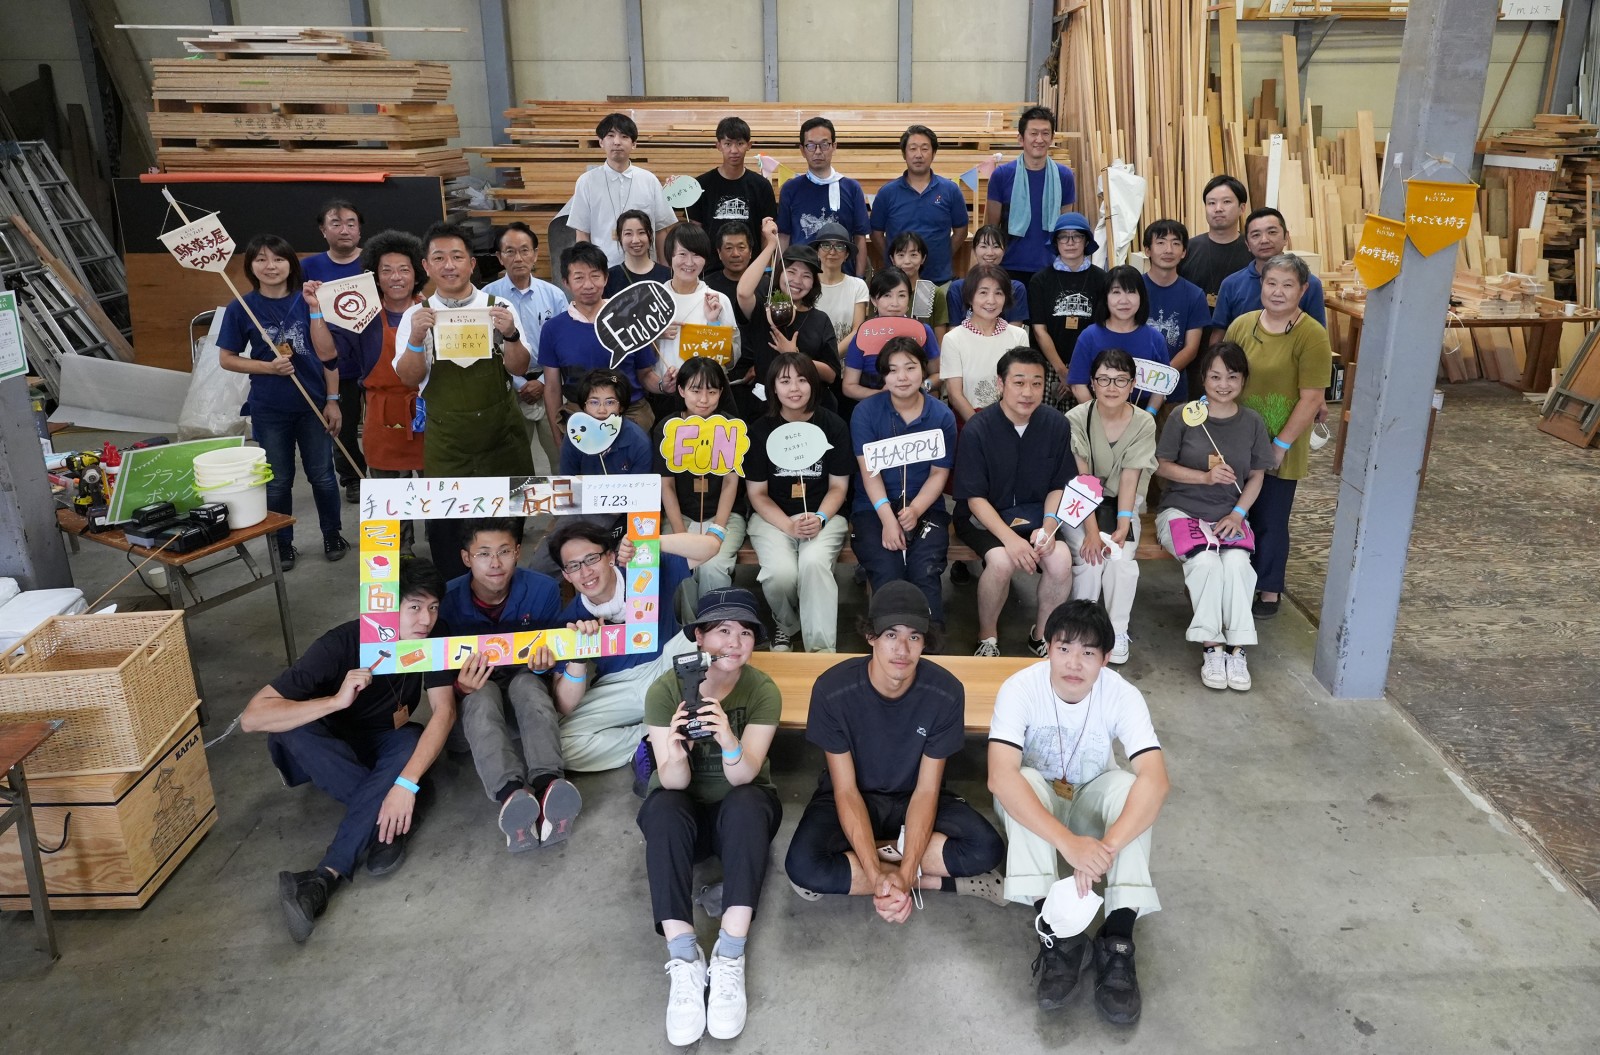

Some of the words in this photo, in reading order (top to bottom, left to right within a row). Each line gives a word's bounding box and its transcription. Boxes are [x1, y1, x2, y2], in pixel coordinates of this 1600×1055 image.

[1408, 213, 1468, 230] 木のこども椅子
[173, 227, 230, 261] 駄菓子屋
[1358, 244, 1401, 267] 木の学童椅子
[601, 282, 673, 352] Enjoy!!
[863, 327, 895, 337] 手しごと
[445, 342, 482, 350] CURRY
[682, 338, 727, 352] ハンギング
[1137, 367, 1175, 389] APPY
[673, 424, 738, 470] FUN
[870, 436, 939, 469] HAPPY
[406, 480, 460, 491] AIBA
[600, 495, 628, 507] 7.23
[1064, 498, 1085, 518] 氷
[174, 734, 199, 761] KAPLA
